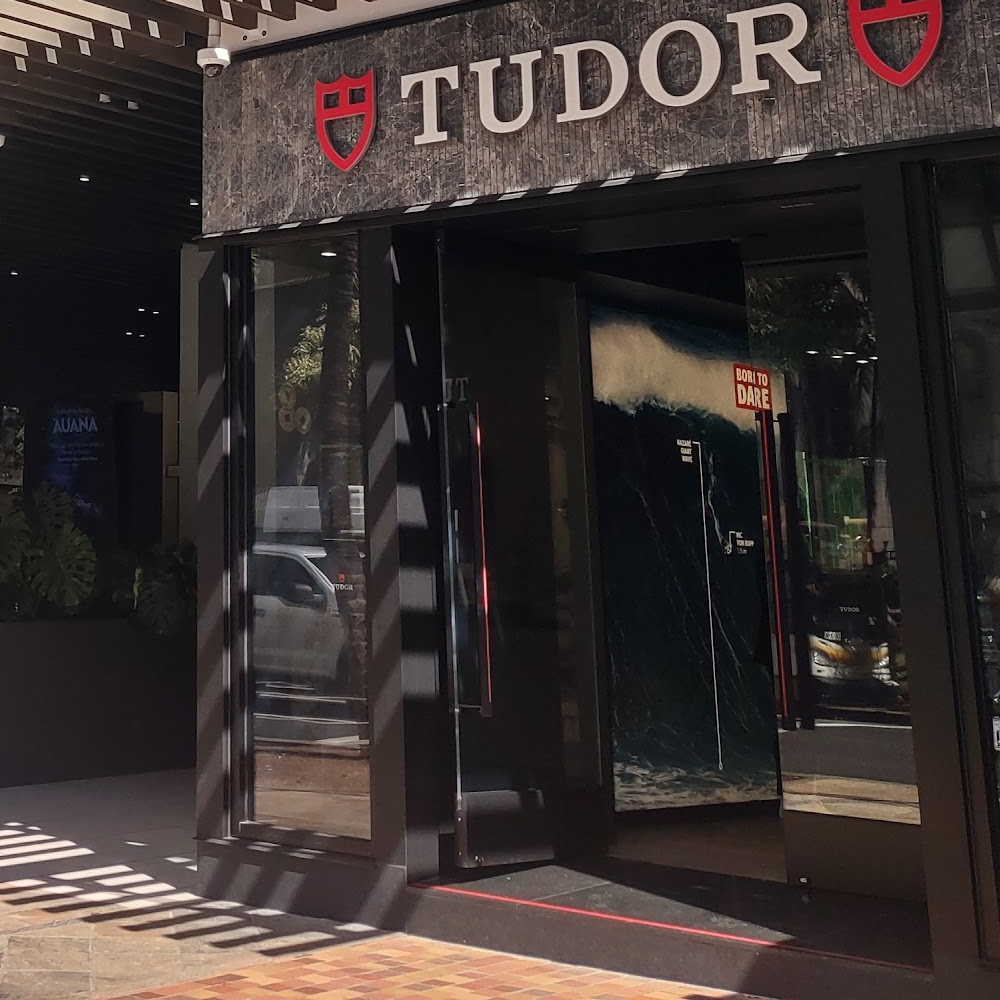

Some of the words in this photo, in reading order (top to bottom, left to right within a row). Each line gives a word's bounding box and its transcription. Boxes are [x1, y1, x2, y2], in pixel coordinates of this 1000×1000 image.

[400, 2, 821, 146] TUDOR
[757, 372, 768, 387] TO
[737, 383, 770, 409] DARE
